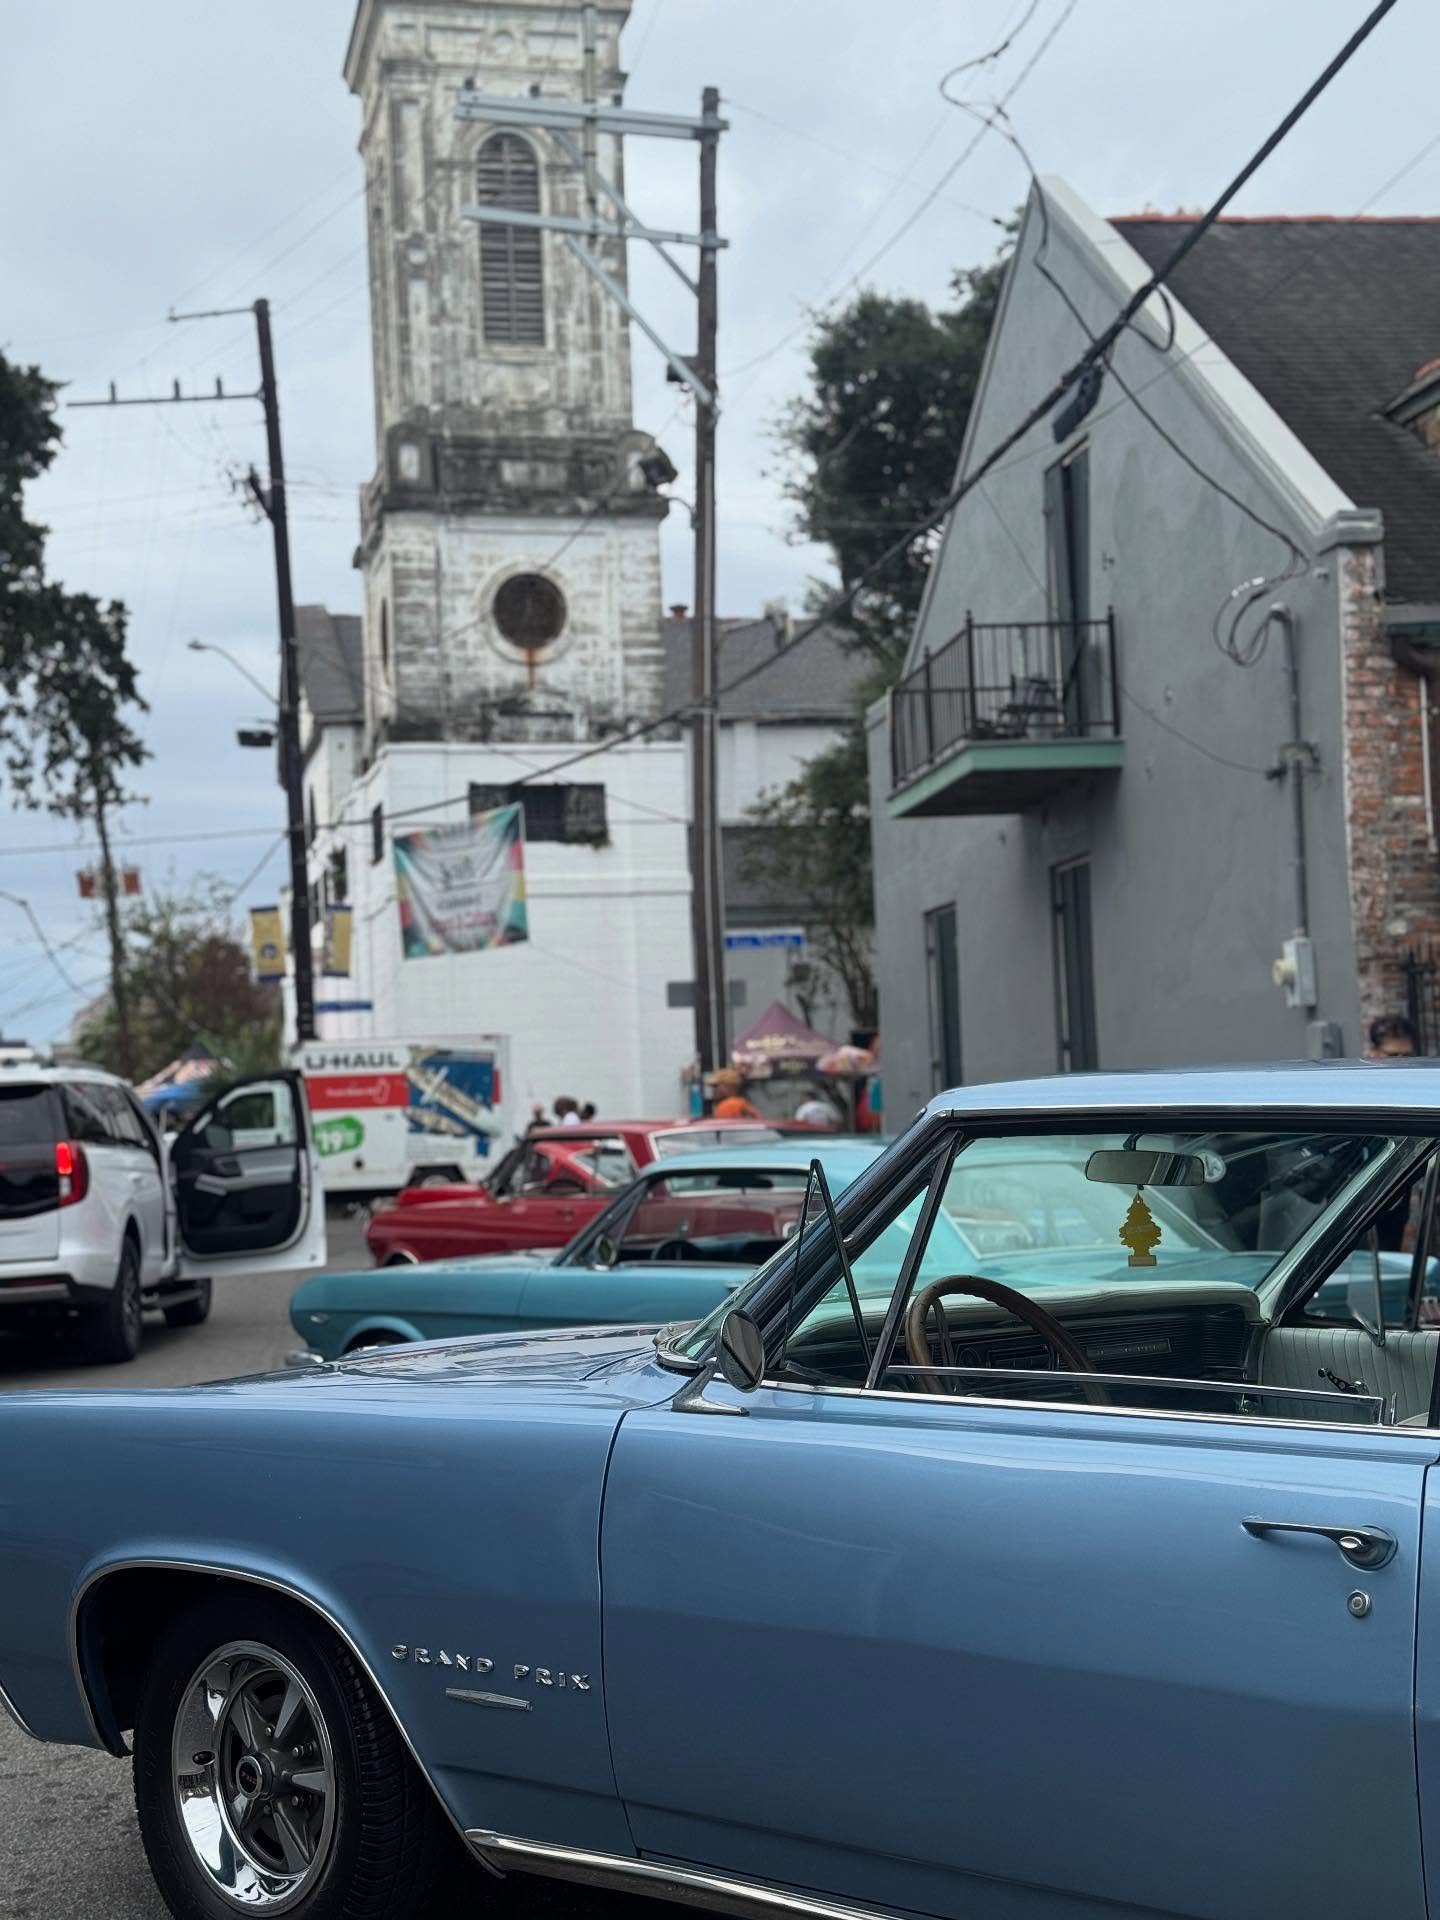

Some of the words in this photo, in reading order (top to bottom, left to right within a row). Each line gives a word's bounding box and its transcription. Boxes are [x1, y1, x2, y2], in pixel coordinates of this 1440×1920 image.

[305, 1052, 399, 1070] U-HAUL
[391, 1644, 495, 1673] GRAND
[513, 1664, 591, 1690] PRIX
